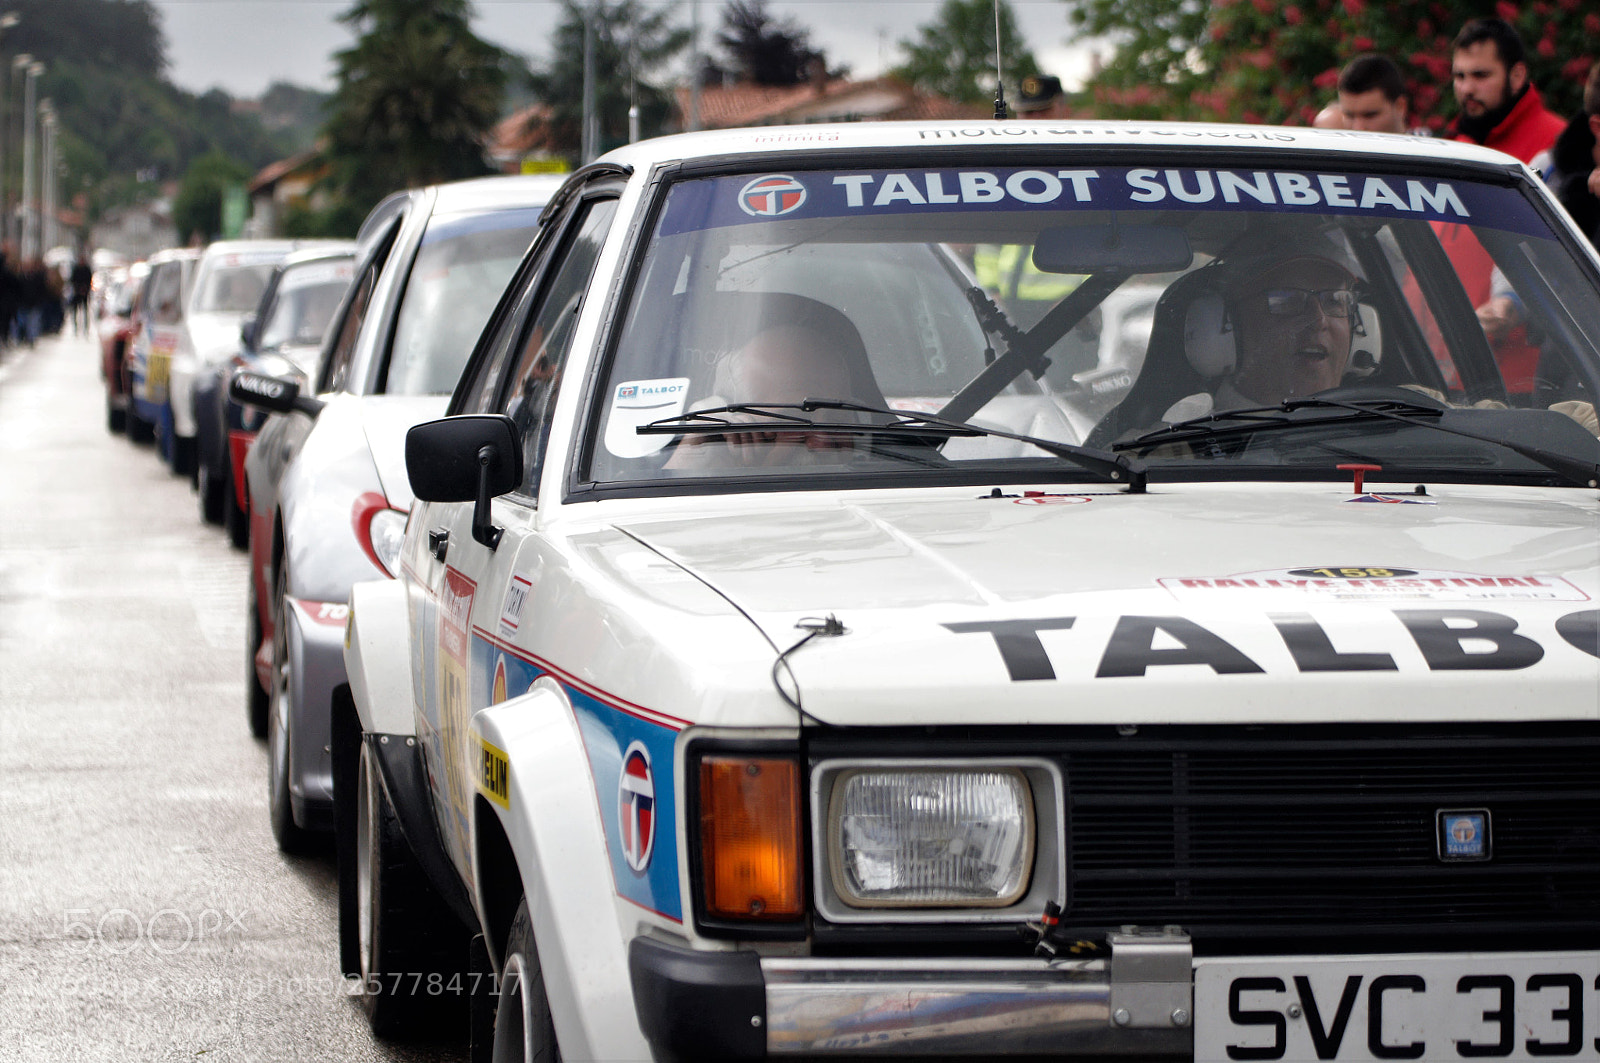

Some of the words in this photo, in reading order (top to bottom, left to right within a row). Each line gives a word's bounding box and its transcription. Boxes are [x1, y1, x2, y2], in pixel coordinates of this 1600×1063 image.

[832, 169, 1100, 208] TALBOT
[1125, 168, 1471, 217] SUNBEAM
[641, 385, 683, 394] TALBOT
[1313, 568, 1394, 577] 158
[1178, 579, 1339, 588] RALLYE
[1347, 577, 1552, 588] FESTIVAL
[938, 609, 1600, 682] TALB
[1447, 844, 1482, 853] TALBOT
[1226, 974, 1426, 1060] SVC
[1456, 973, 1600, 1058] 33
